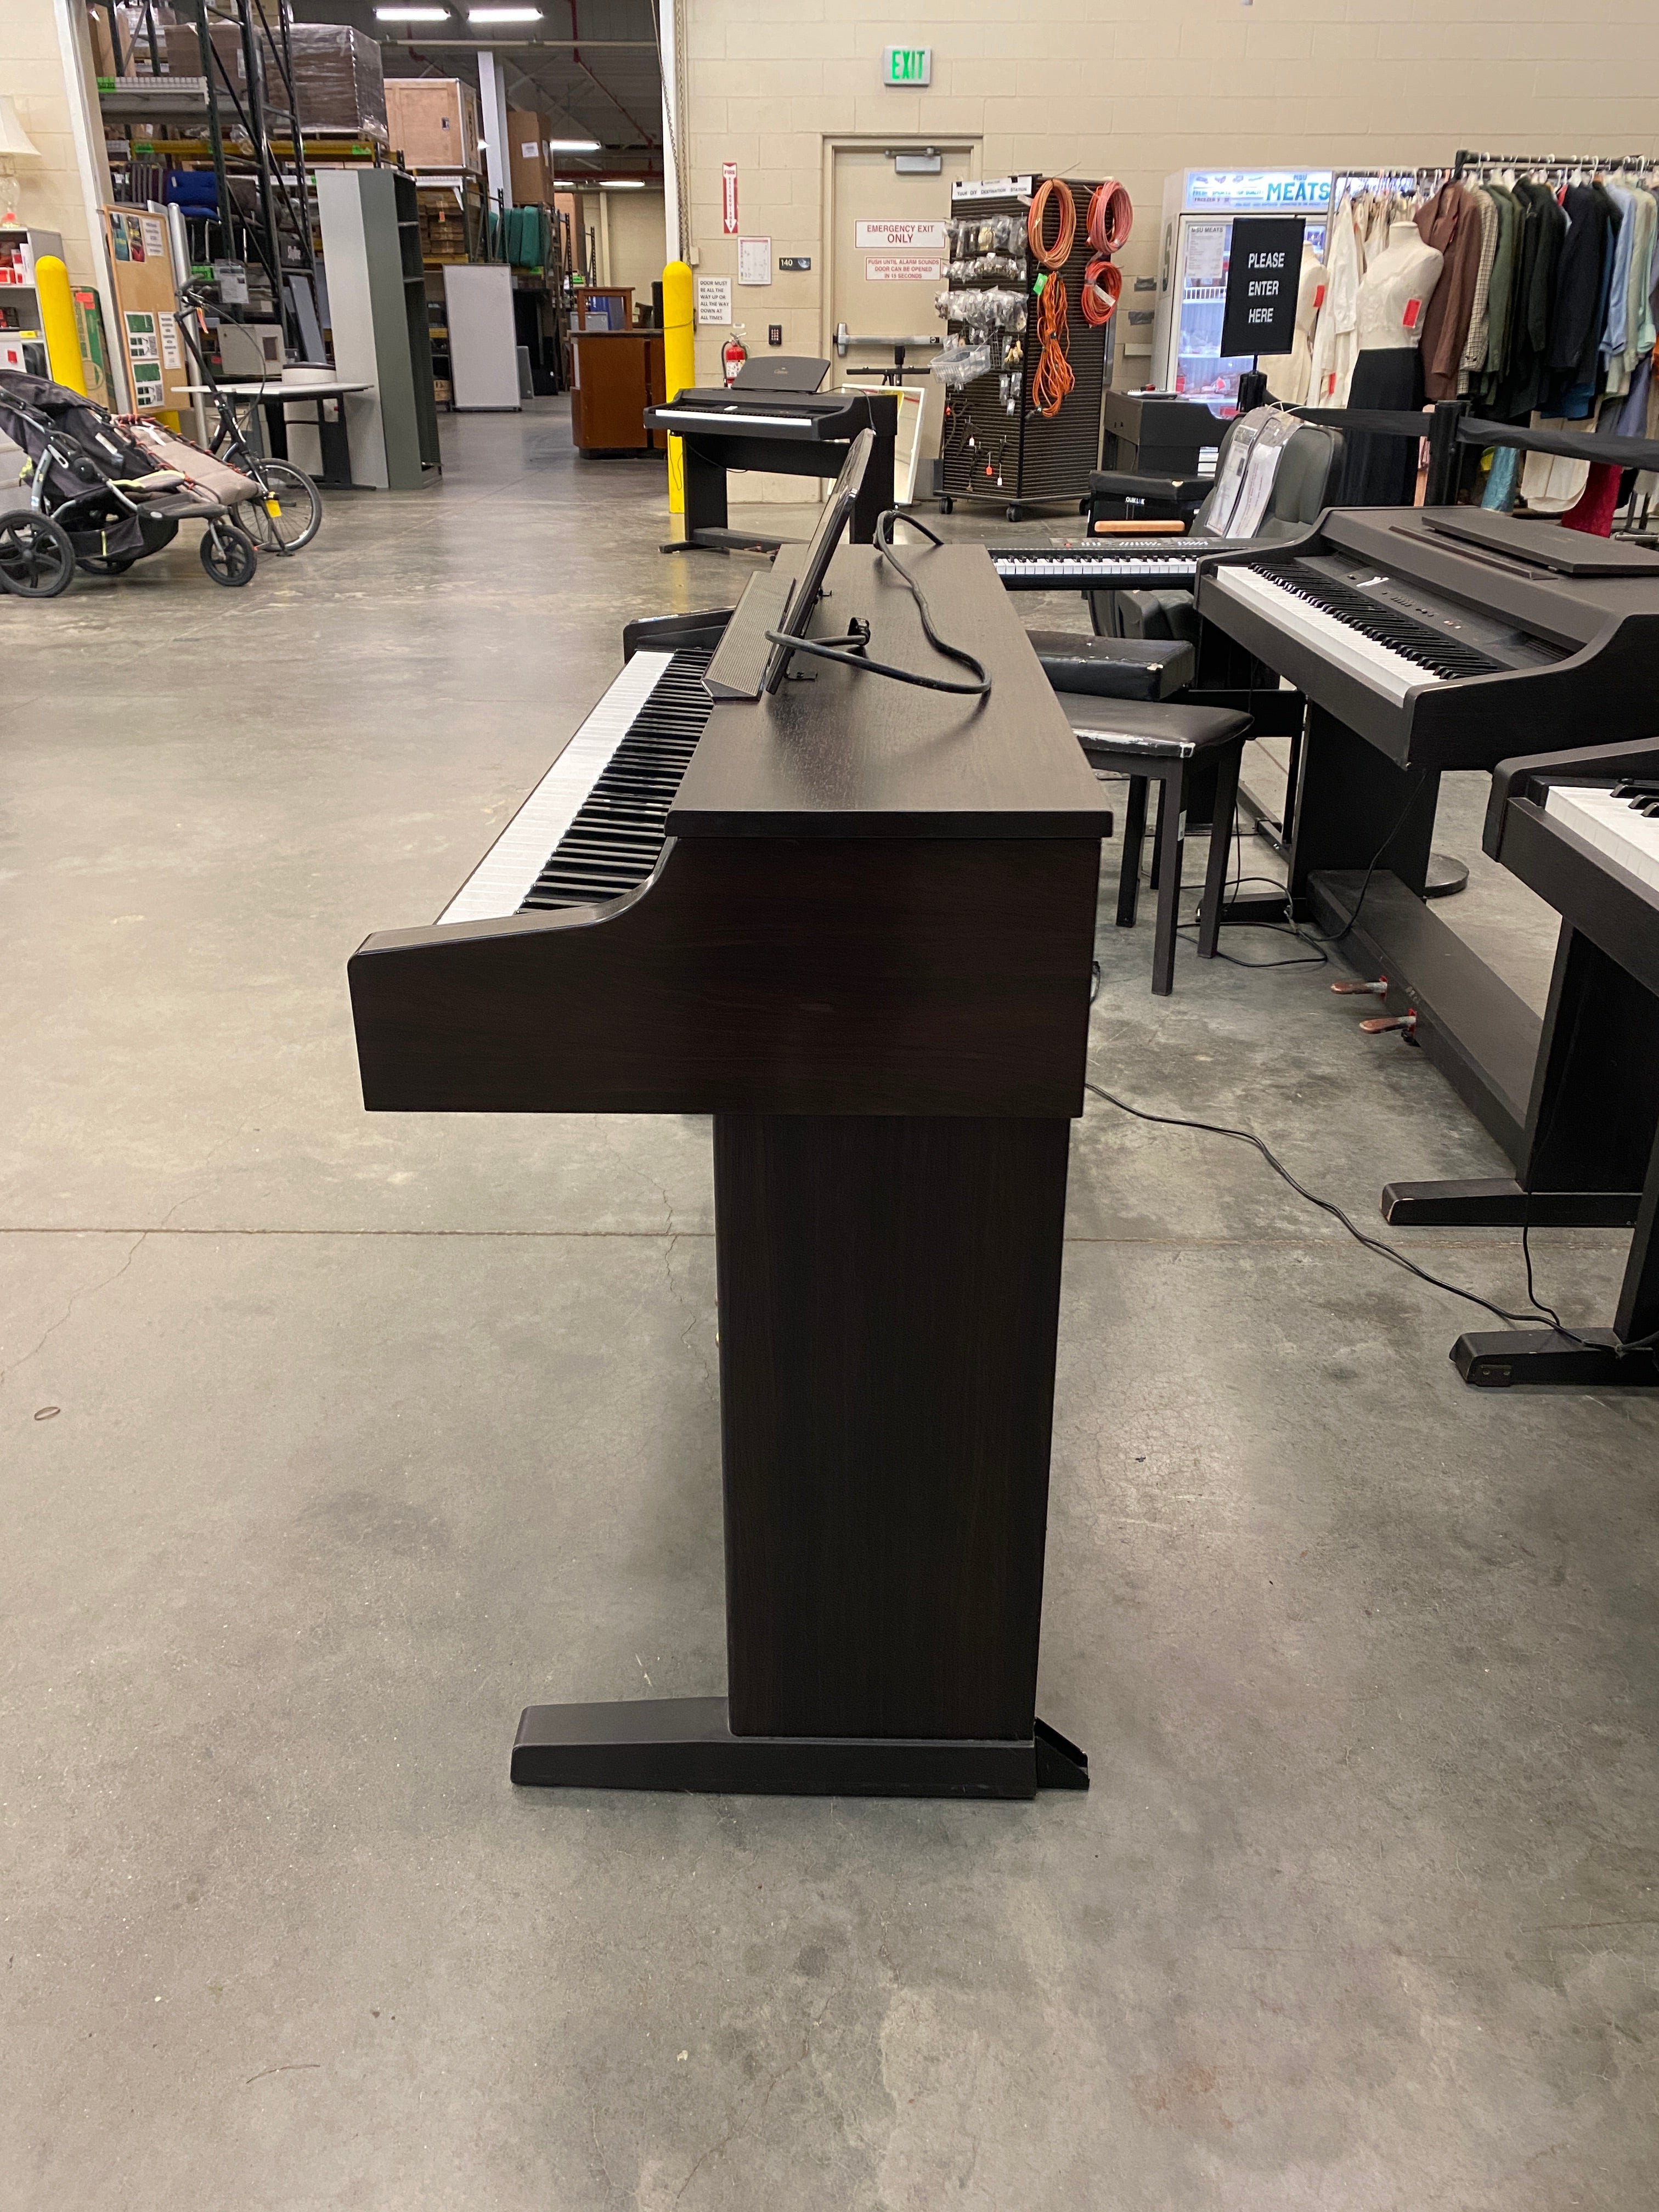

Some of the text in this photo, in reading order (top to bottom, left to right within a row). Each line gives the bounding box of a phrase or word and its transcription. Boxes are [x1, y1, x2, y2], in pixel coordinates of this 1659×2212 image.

[892, 50, 925, 79] EXIT
[1266, 182, 1330, 201] MEATS
[887, 234, 913, 243] ONLY
[1248, 252, 1285, 268] PLEASE
[1248, 280, 1279, 296] ENTER
[1248, 308, 1274, 323] HERE
